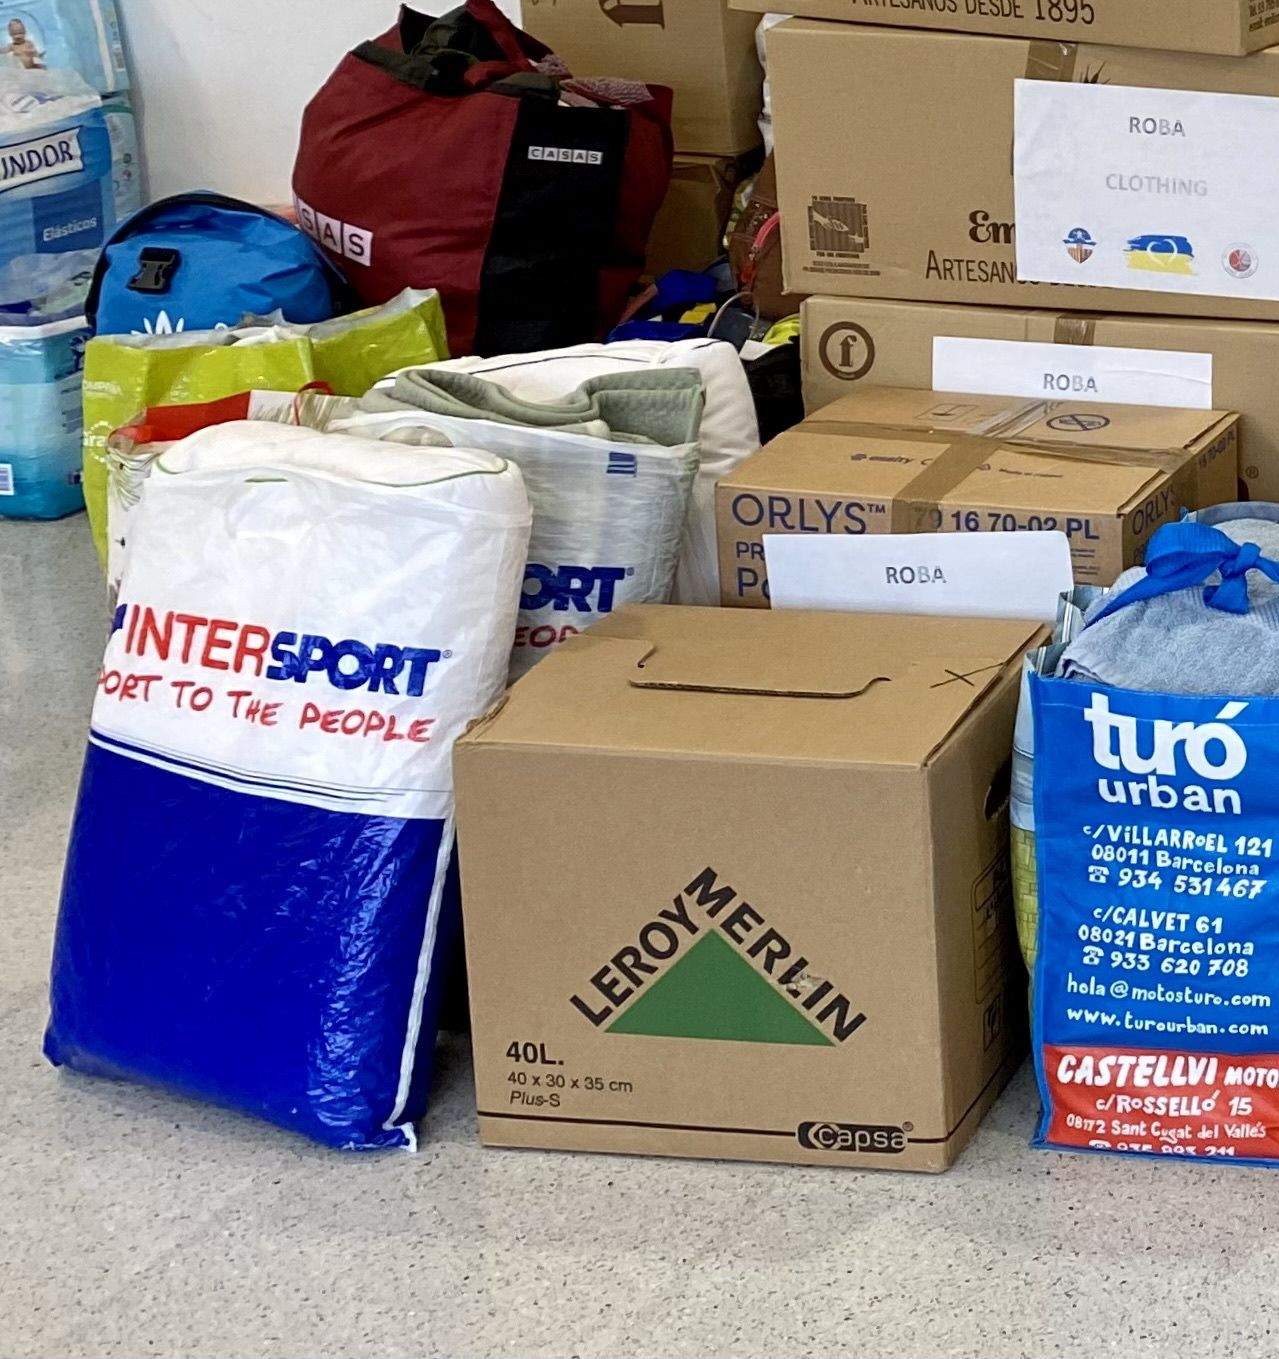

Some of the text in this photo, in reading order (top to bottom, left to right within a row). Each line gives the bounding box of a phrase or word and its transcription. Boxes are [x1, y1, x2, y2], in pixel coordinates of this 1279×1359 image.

[1129, 116, 1186, 138] ROBA
[529, 148, 602, 163] CASAS
[1105, 173, 1208, 197] CLOTHING
[43, 217, 97, 241] Elásticos
[1044, 373, 1098, 393] ROBA
[952, 508, 978, 531] 16
[989, 510, 1057, 530] 70-02
[1065, 520, 1098, 539] PL
[887, 567, 946, 583] ROBA
[124, 604, 442, 695] INTERSPORT
[170, 680, 213, 711] TO
[227, 691, 280, 725] THE
[300, 701, 434, 742] PEOPLE
[1084, 691, 1250, 780] turó
[1098, 776, 1242, 814] urban
[1092, 844, 1259, 875] 08011 Barcelona
[1235, 838, 1273, 857] 121
[1118, 869, 1162, 889] 934
[1093, 906, 1223, 934] c/CALVET 61
[1078, 926, 1254, 956] 08021 Barcelona
[570, 867, 866, 1042] LEROY MERLIN
[1111, 951, 1249, 977] 933 620 708
[1067, 1007, 1269, 1035] www.turourban.com
[506, 1040, 564, 1065] 40L.
[508, 1072, 633, 1092] 40 x 30 x 35 cm
[510, 1090, 560, 1107] Plus-S
[1228, 1096, 1253, 1116] 15
[817, 1125, 906, 1151] capsa
[1066, 1114, 1105, 1133] 08172
[1111, 1121, 1146, 1137] Sant
[1151, 1122, 1192, 1144] Cugat
[1197, 1124, 1218, 1139] del
